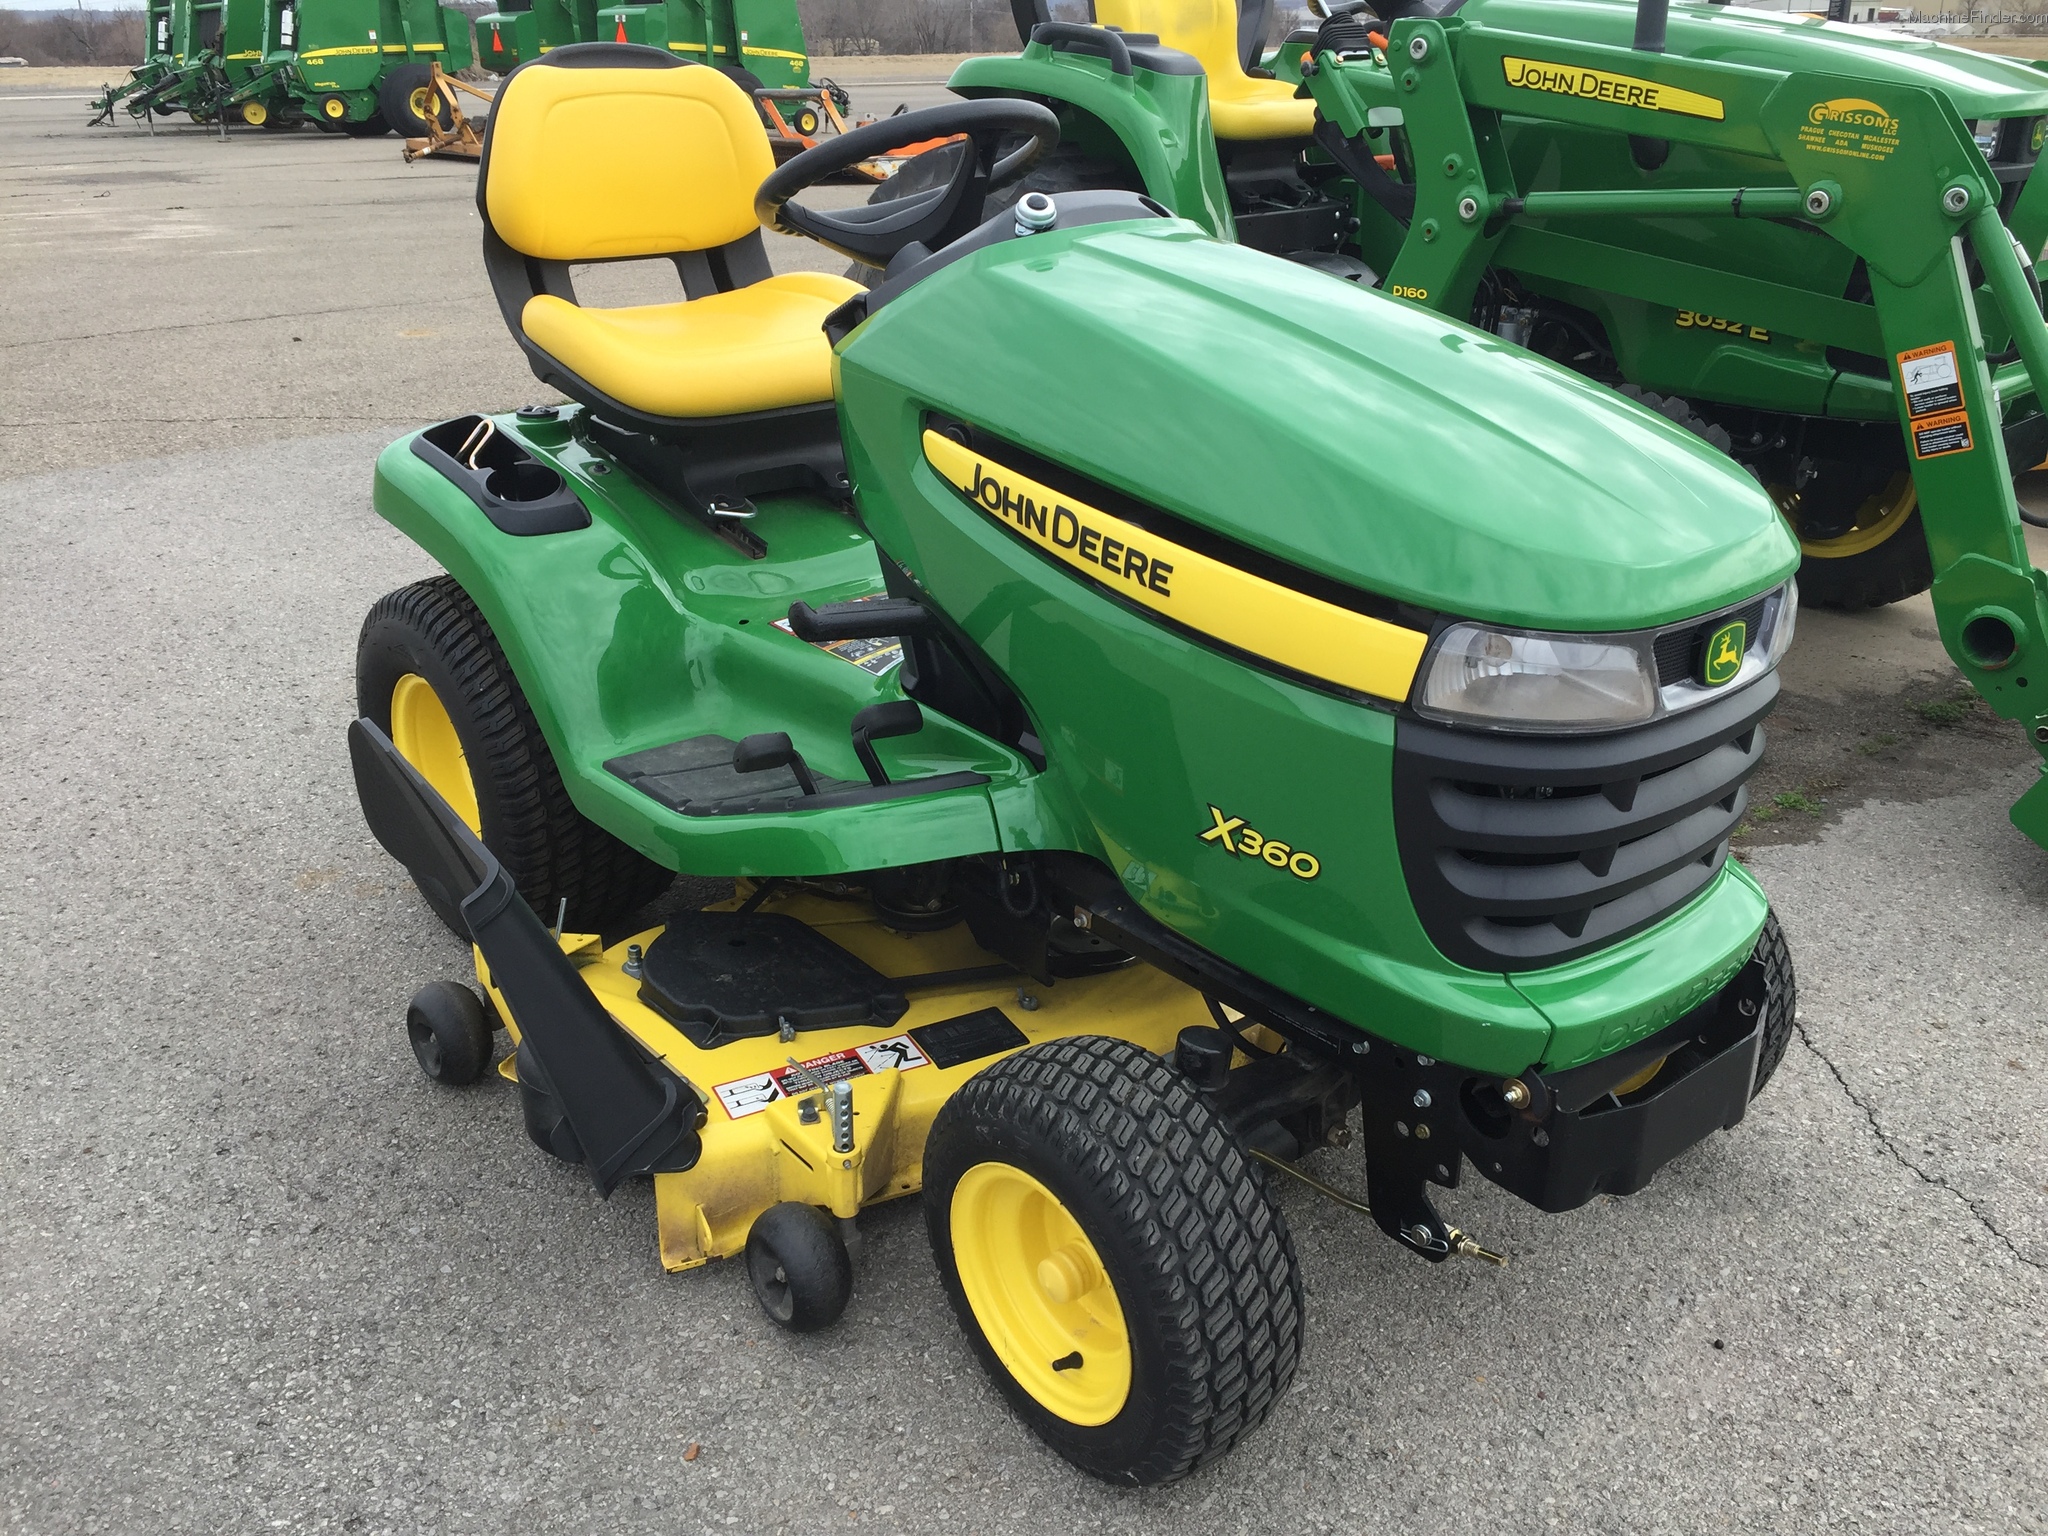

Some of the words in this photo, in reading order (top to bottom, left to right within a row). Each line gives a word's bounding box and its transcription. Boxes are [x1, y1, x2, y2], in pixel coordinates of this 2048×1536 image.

[306, 58, 324, 66] 468
[789, 59, 804, 67] 468
[1511, 63, 1575, 92] JOHN
[1579, 73, 1660, 107] DEERE
[1800, 125, 1825, 135] PRAGUE
[1883, 128, 1897, 136] LLC
[1798, 133, 1826, 143] SHAWNEE
[1861, 143, 1895, 154] MUSKOGEE
[1392, 285, 1428, 300] D160
[1911, 345, 1947, 359] WARNING
[1925, 415, 1962, 428] WARNING
[964, 462, 1047, 537] JOHN
[1051, 504, 1174, 598] DEERE
[1197, 803, 1321, 879] X360
